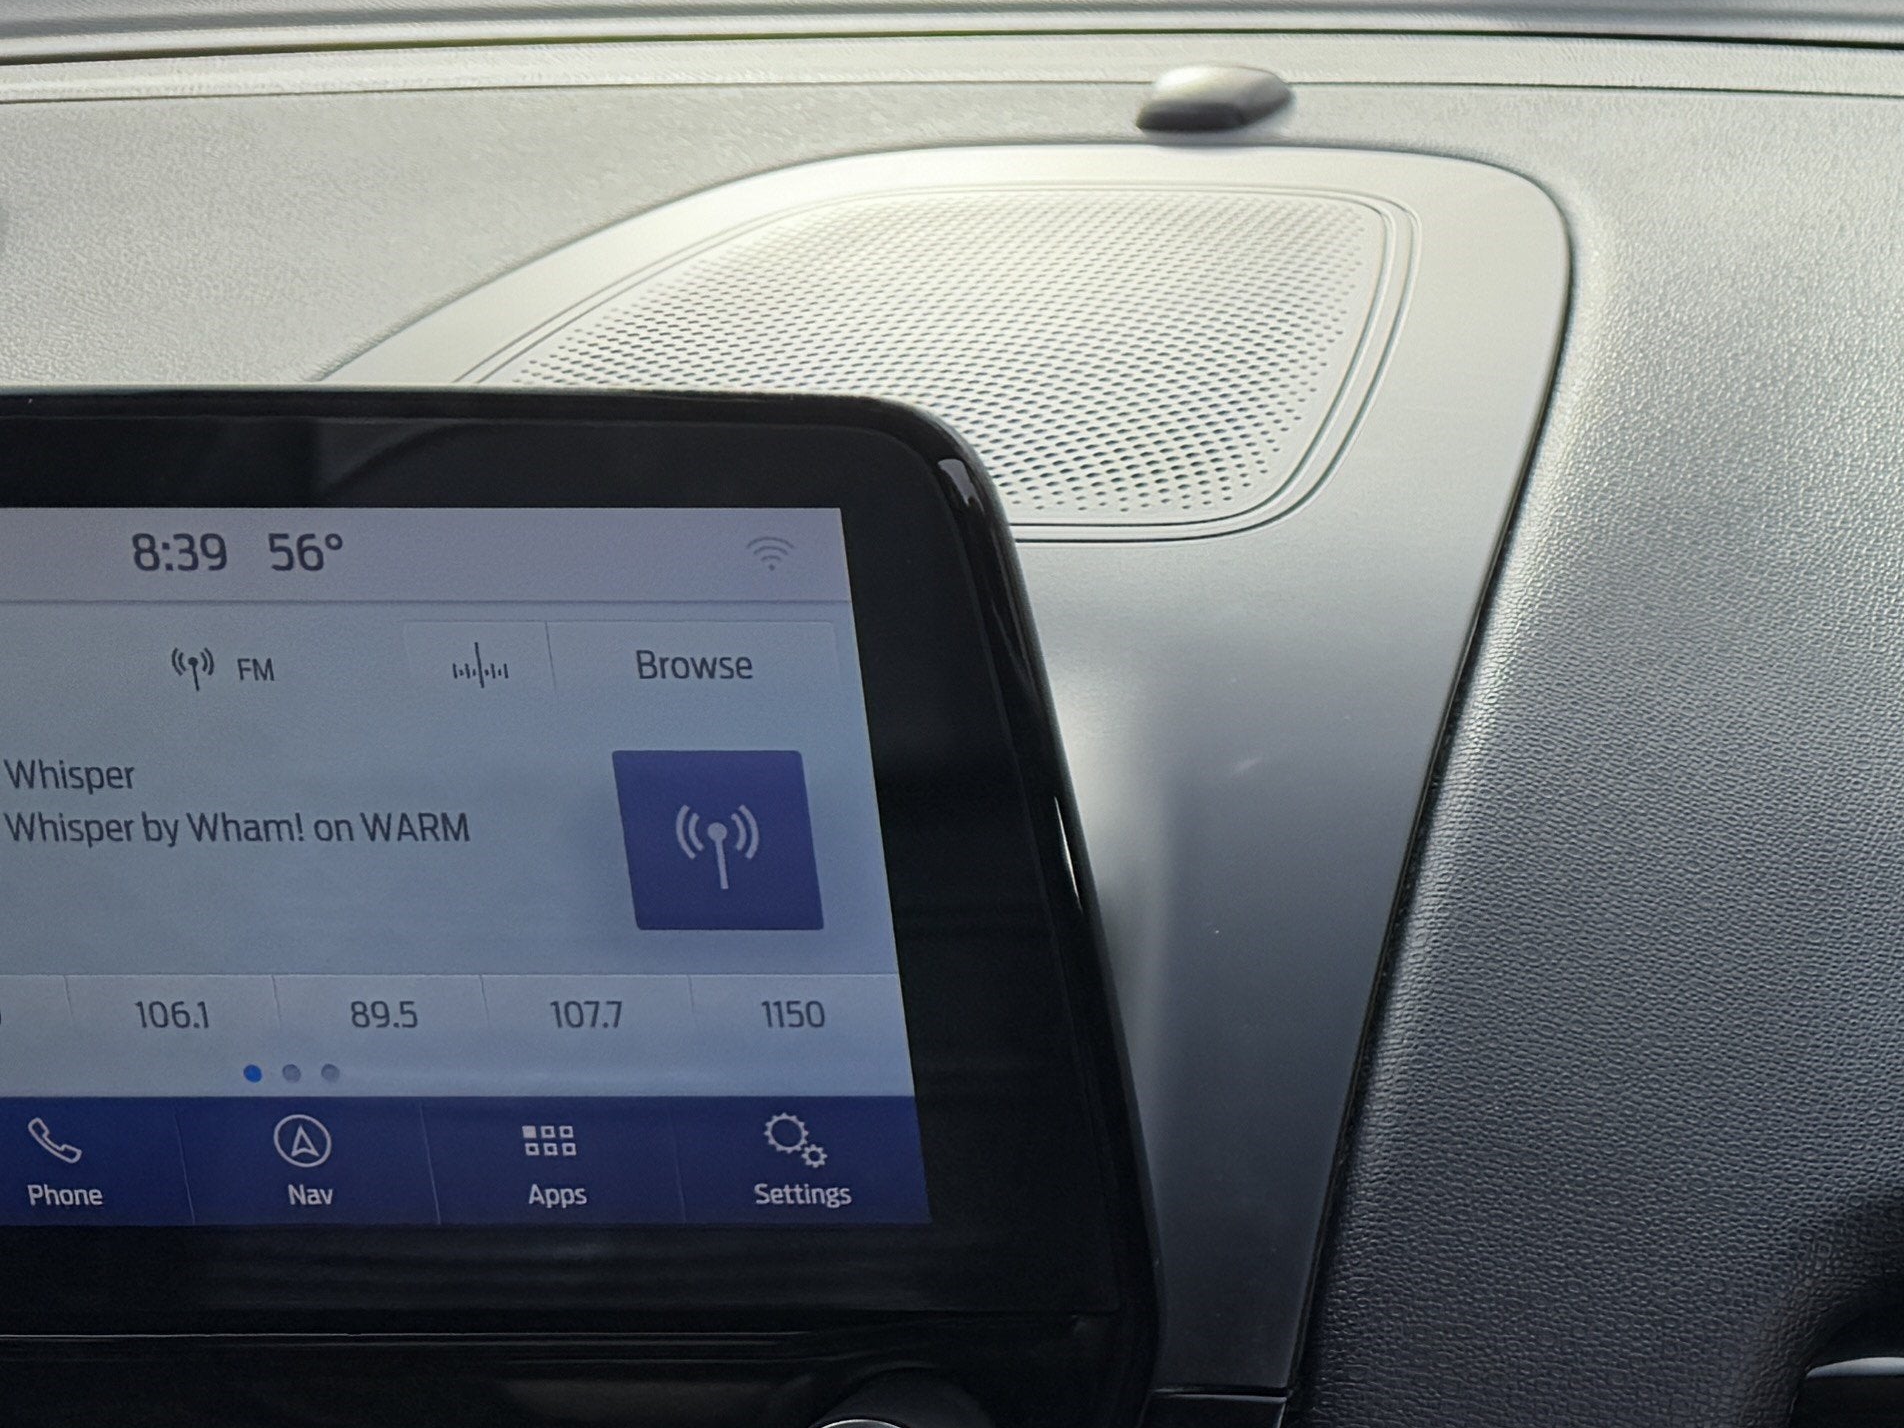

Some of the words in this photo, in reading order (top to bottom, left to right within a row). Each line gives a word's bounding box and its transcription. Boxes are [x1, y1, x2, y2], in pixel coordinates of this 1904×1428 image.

[131, 532, 229, 573] 8:39
[267, 531, 345, 573] 56°
[236, 657, 276, 682] FM
[635, 648, 754, 681] Browse
[3, 758, 136, 795] Whisper
[3, 811, 136, 849] Whisper
[140, 811, 180, 848] by
[185, 811, 306, 843] Wham!
[312, 818, 356, 843] on
[359, 811, 471, 843] WARM
[134, 999, 210, 1030] 106.1
[349, 999, 419, 1030] 89.5
[549, 999, 623, 1030] 107.7
[760, 999, 827, 1030] 1150
[26, 1182, 104, 1208] Phone
[287, 1183, 334, 1207] Nav
[527, 1183, 588, 1213] Apps
[753, 1181, 853, 1212] Settings
